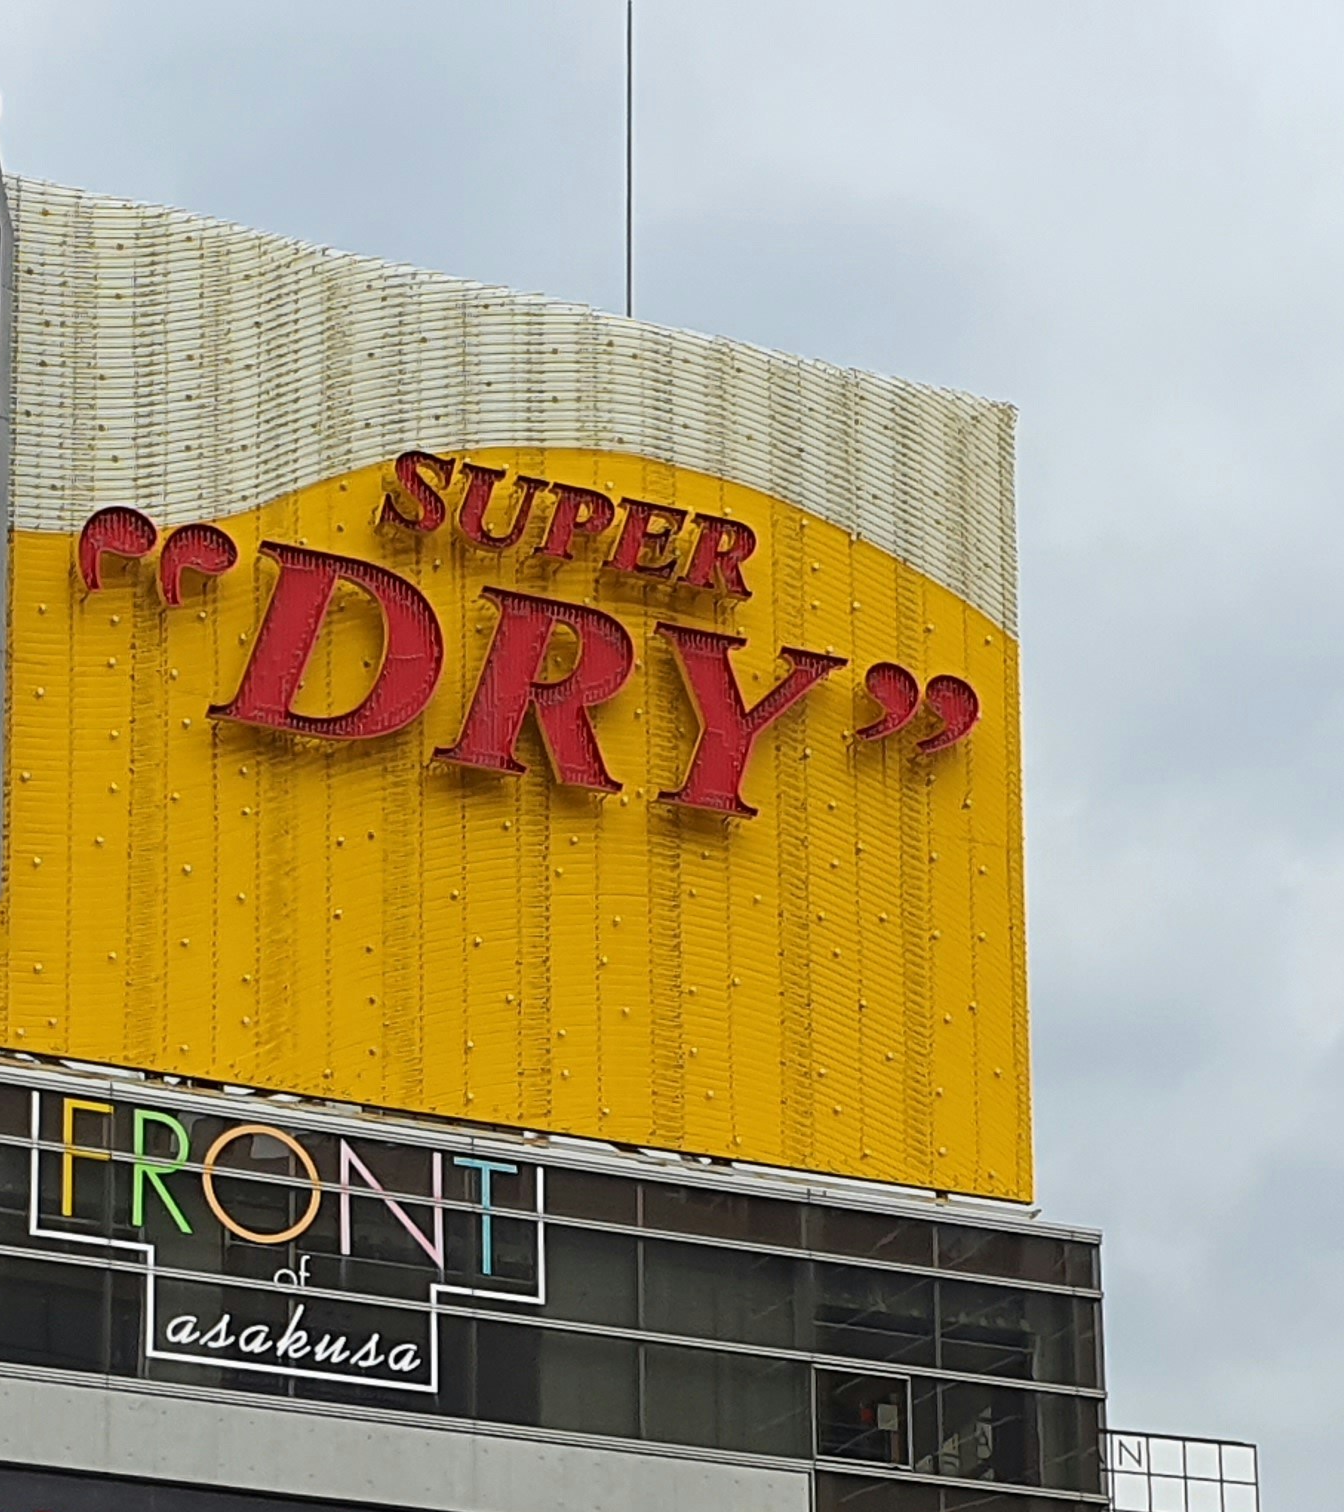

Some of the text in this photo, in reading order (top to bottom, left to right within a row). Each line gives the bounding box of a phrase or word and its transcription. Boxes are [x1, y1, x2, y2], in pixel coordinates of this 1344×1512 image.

[380, 450, 756, 599] SUPER
[63, 1097, 518, 1276] FRONT
[274, 1255, 312, 1289] of
[165, 1303, 423, 1373] asakusa
